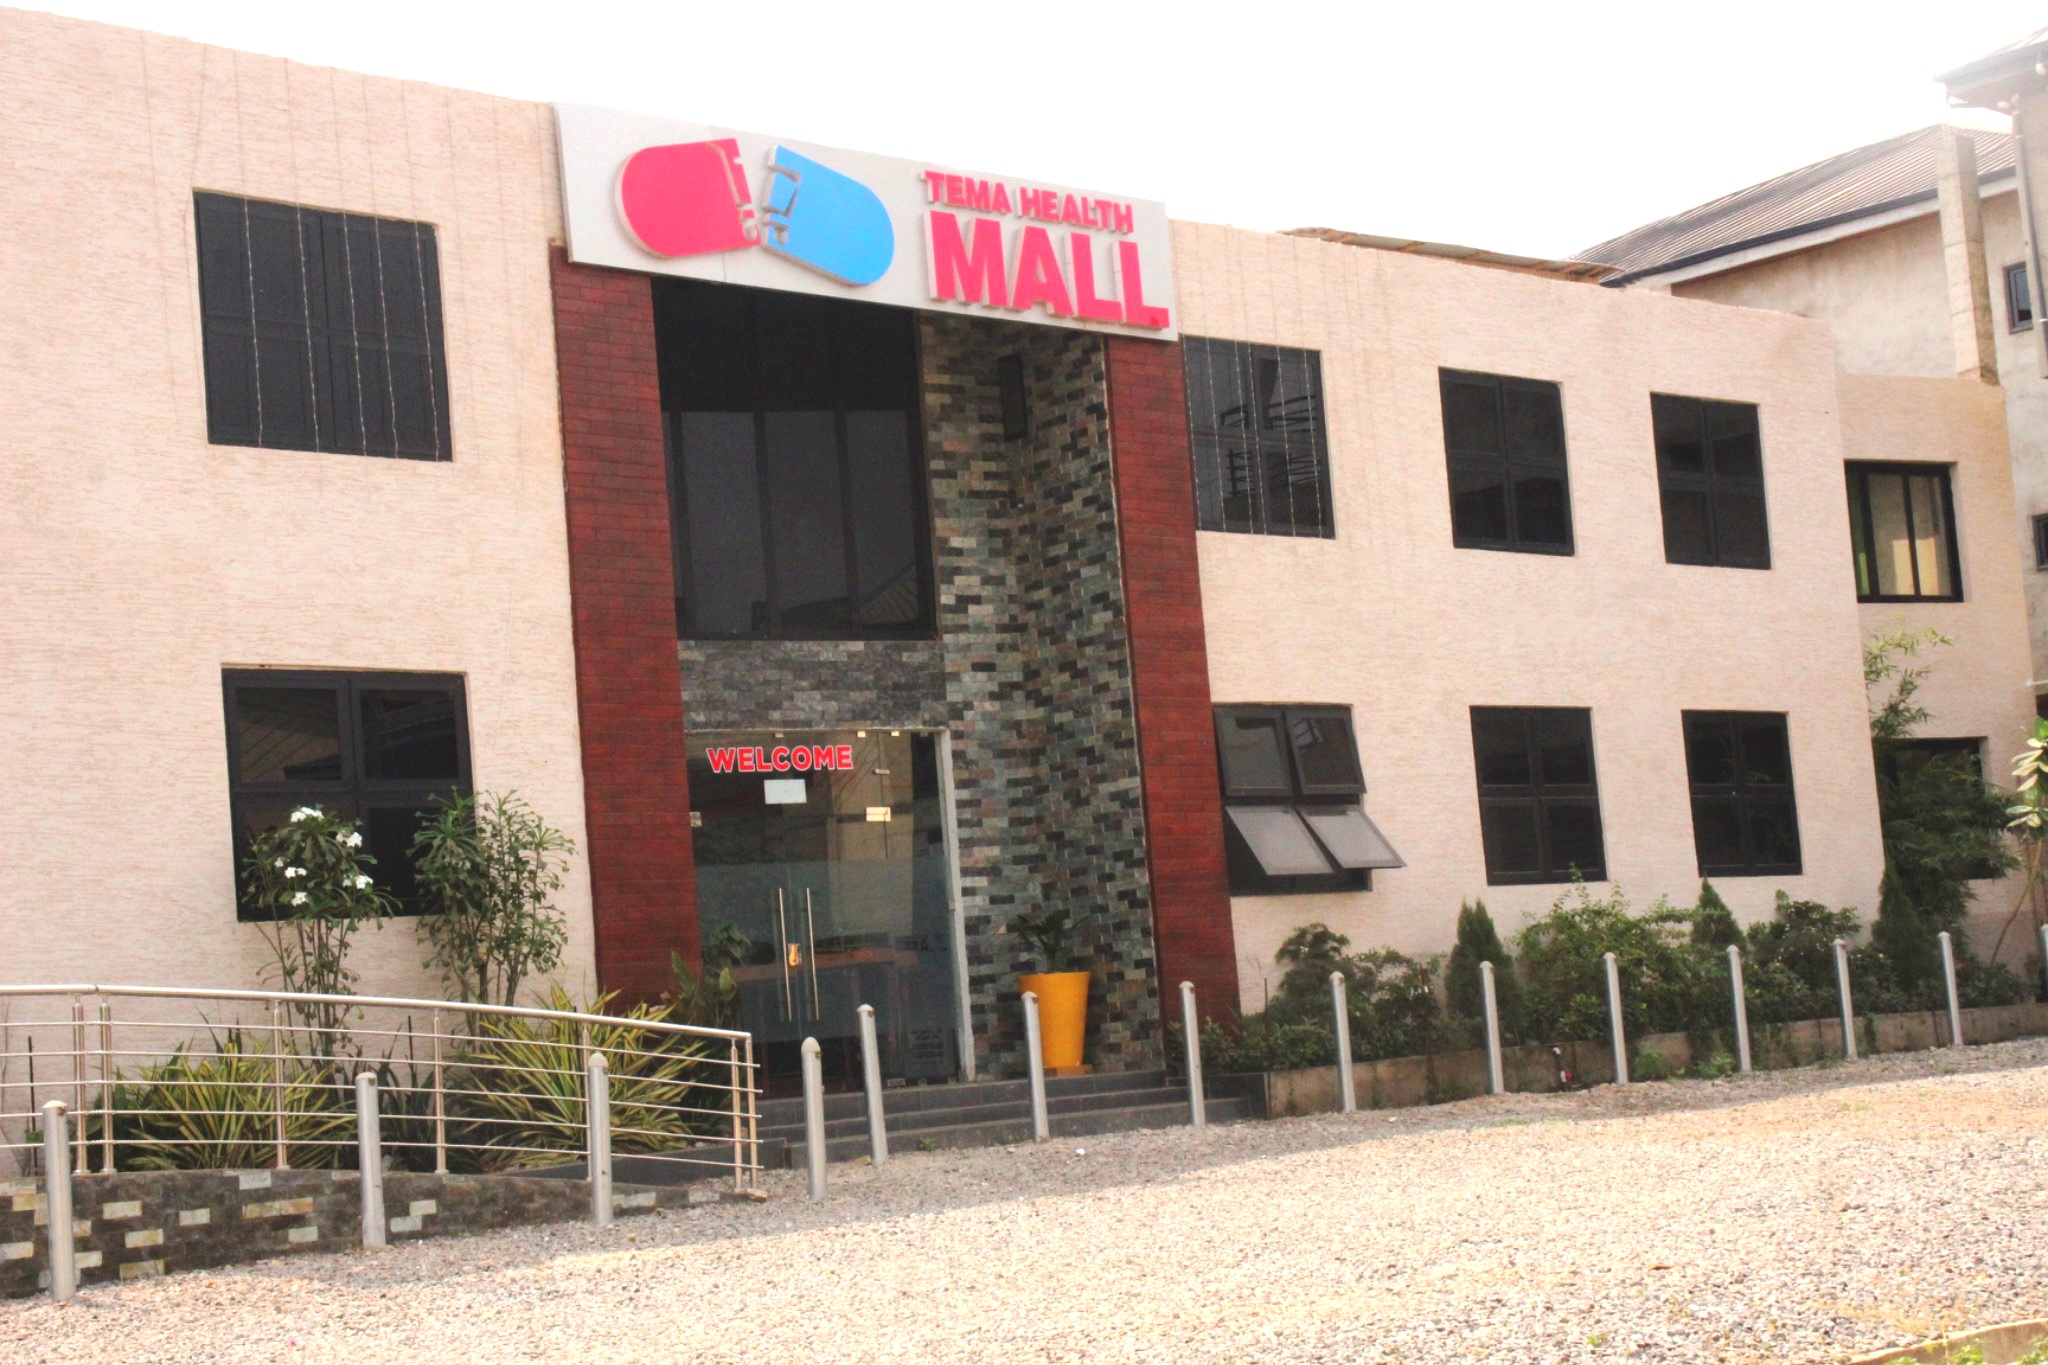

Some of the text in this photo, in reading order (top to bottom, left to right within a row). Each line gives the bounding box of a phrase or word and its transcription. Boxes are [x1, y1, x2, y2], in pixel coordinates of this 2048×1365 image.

[922, 170, 1134, 234] TEMA HEALTH
[925, 210, 1170, 330] MALL
[706, 745, 853, 773] WELCOME
